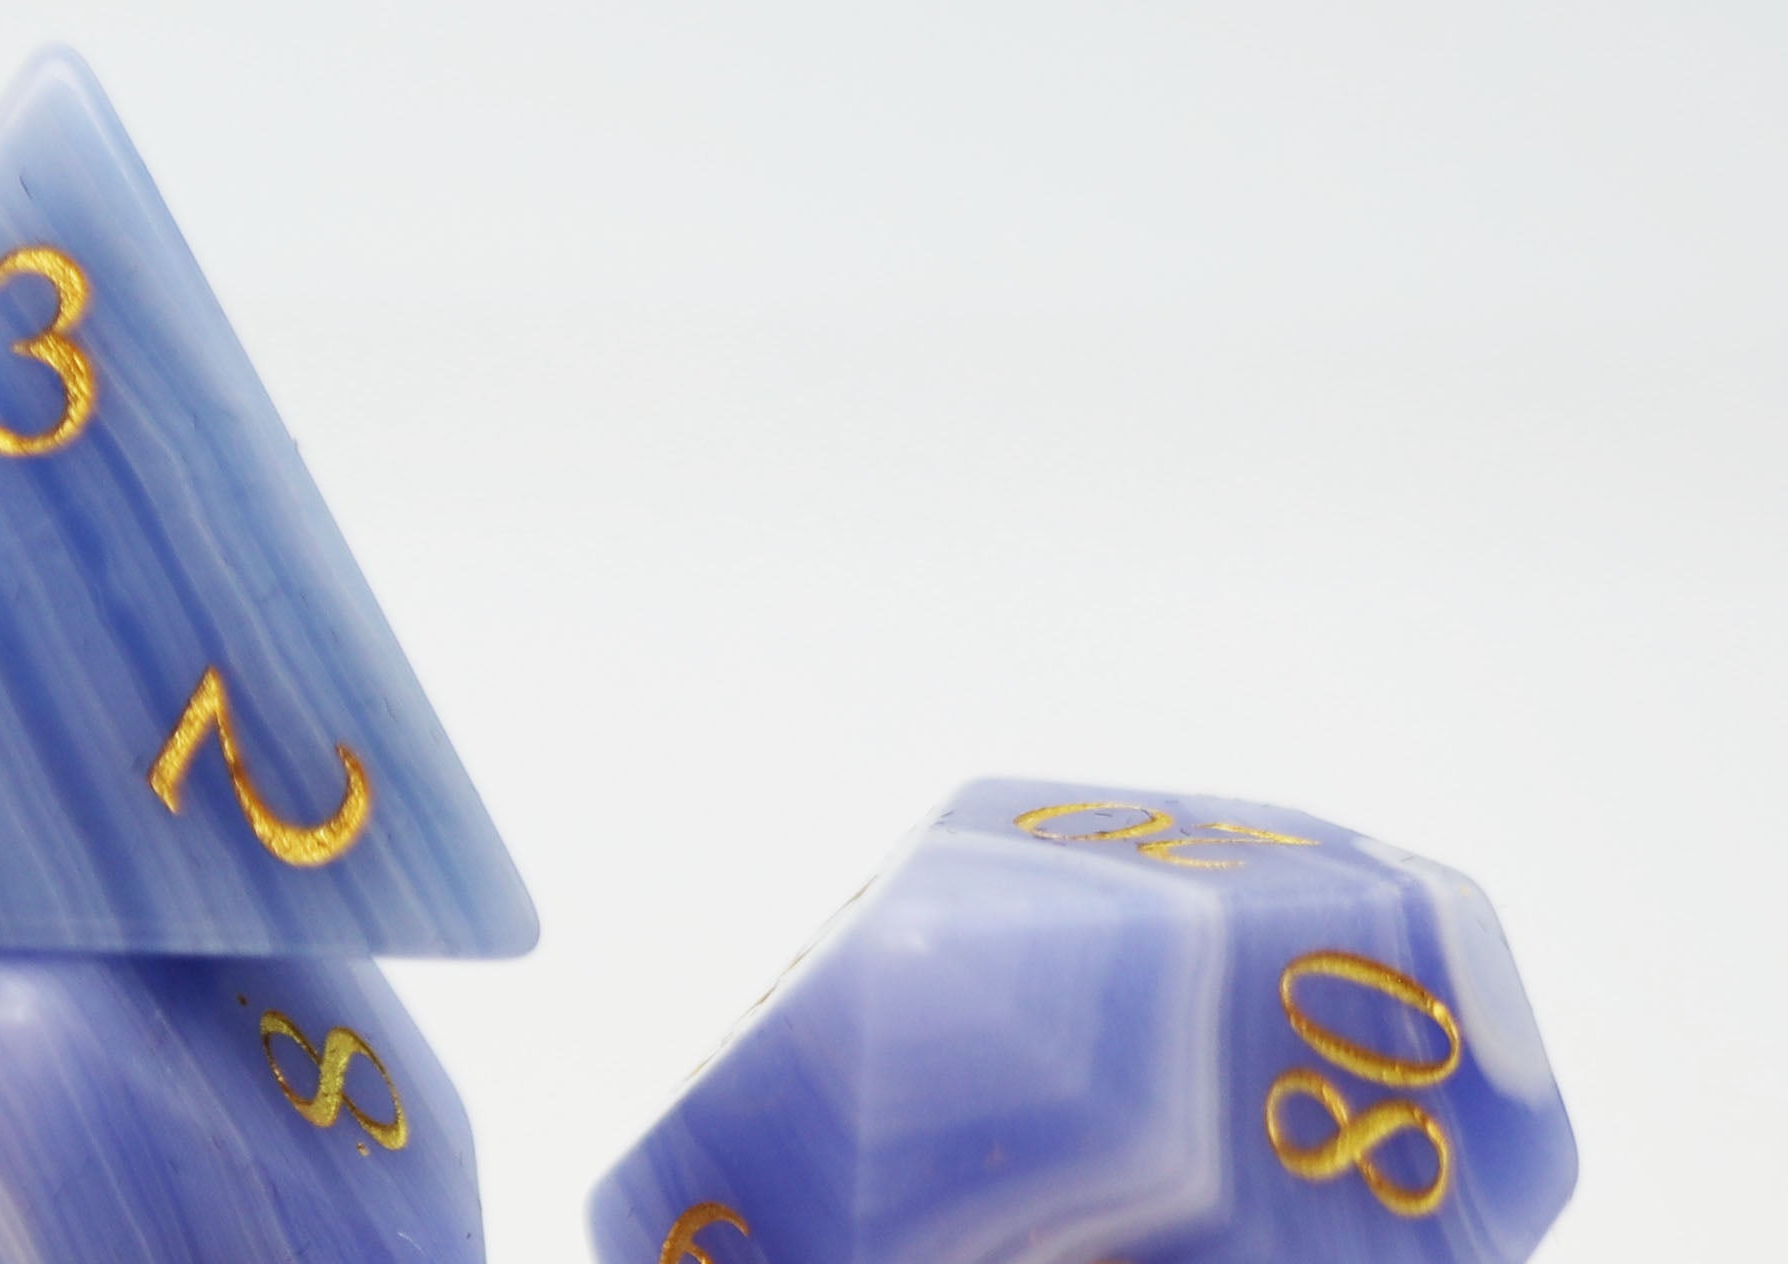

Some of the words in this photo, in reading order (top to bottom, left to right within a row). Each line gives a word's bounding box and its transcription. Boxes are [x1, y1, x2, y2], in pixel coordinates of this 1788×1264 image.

[145, 664, 373, 867] 2
[1012, 800, 1318, 869] 20
[258, 1008, 409, 1152] 8
[1262, 948, 1463, 1217] 80
